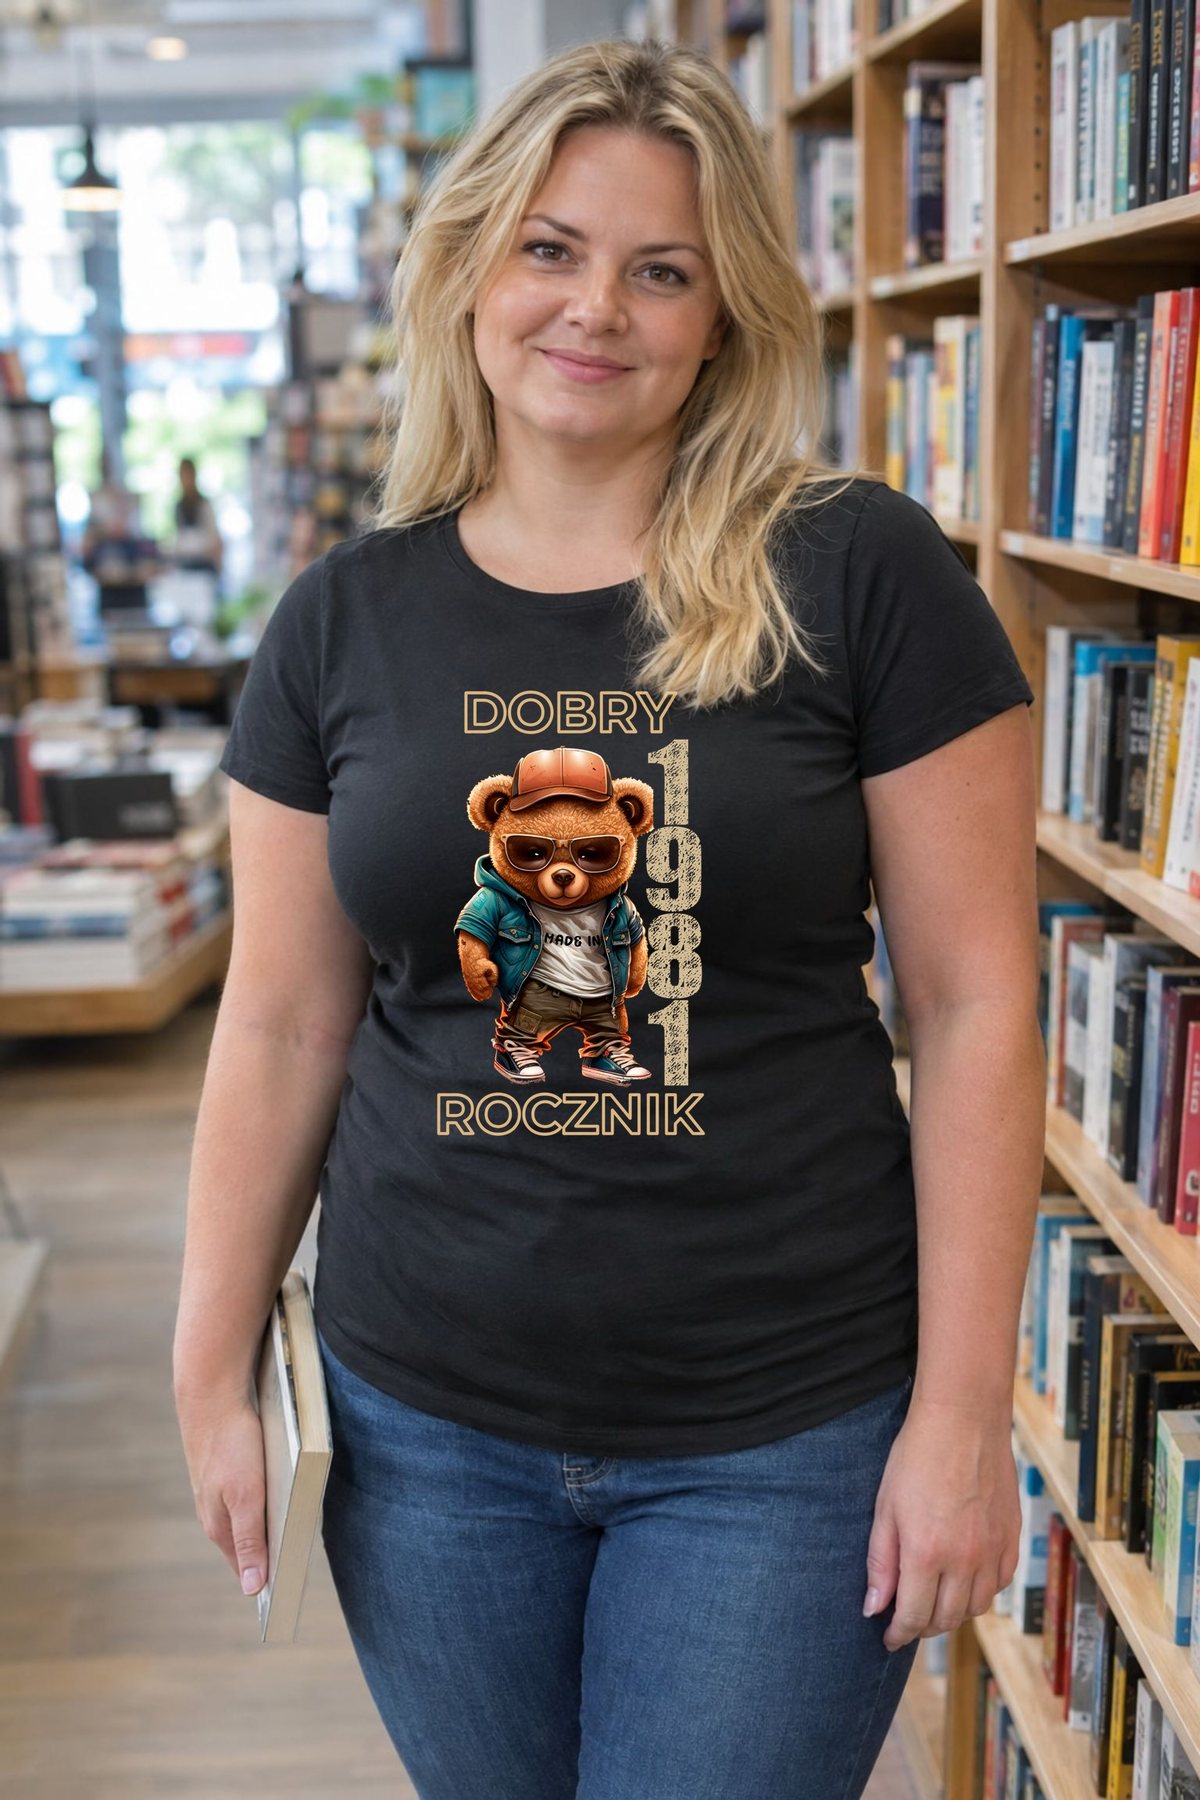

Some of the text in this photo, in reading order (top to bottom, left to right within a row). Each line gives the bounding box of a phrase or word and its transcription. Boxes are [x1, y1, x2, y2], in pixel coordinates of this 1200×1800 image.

[463, 690, 677, 734] DOBRY
[645, 739, 702, 1086] 1981
[436, 1092, 705, 1137] ROCZNIK
